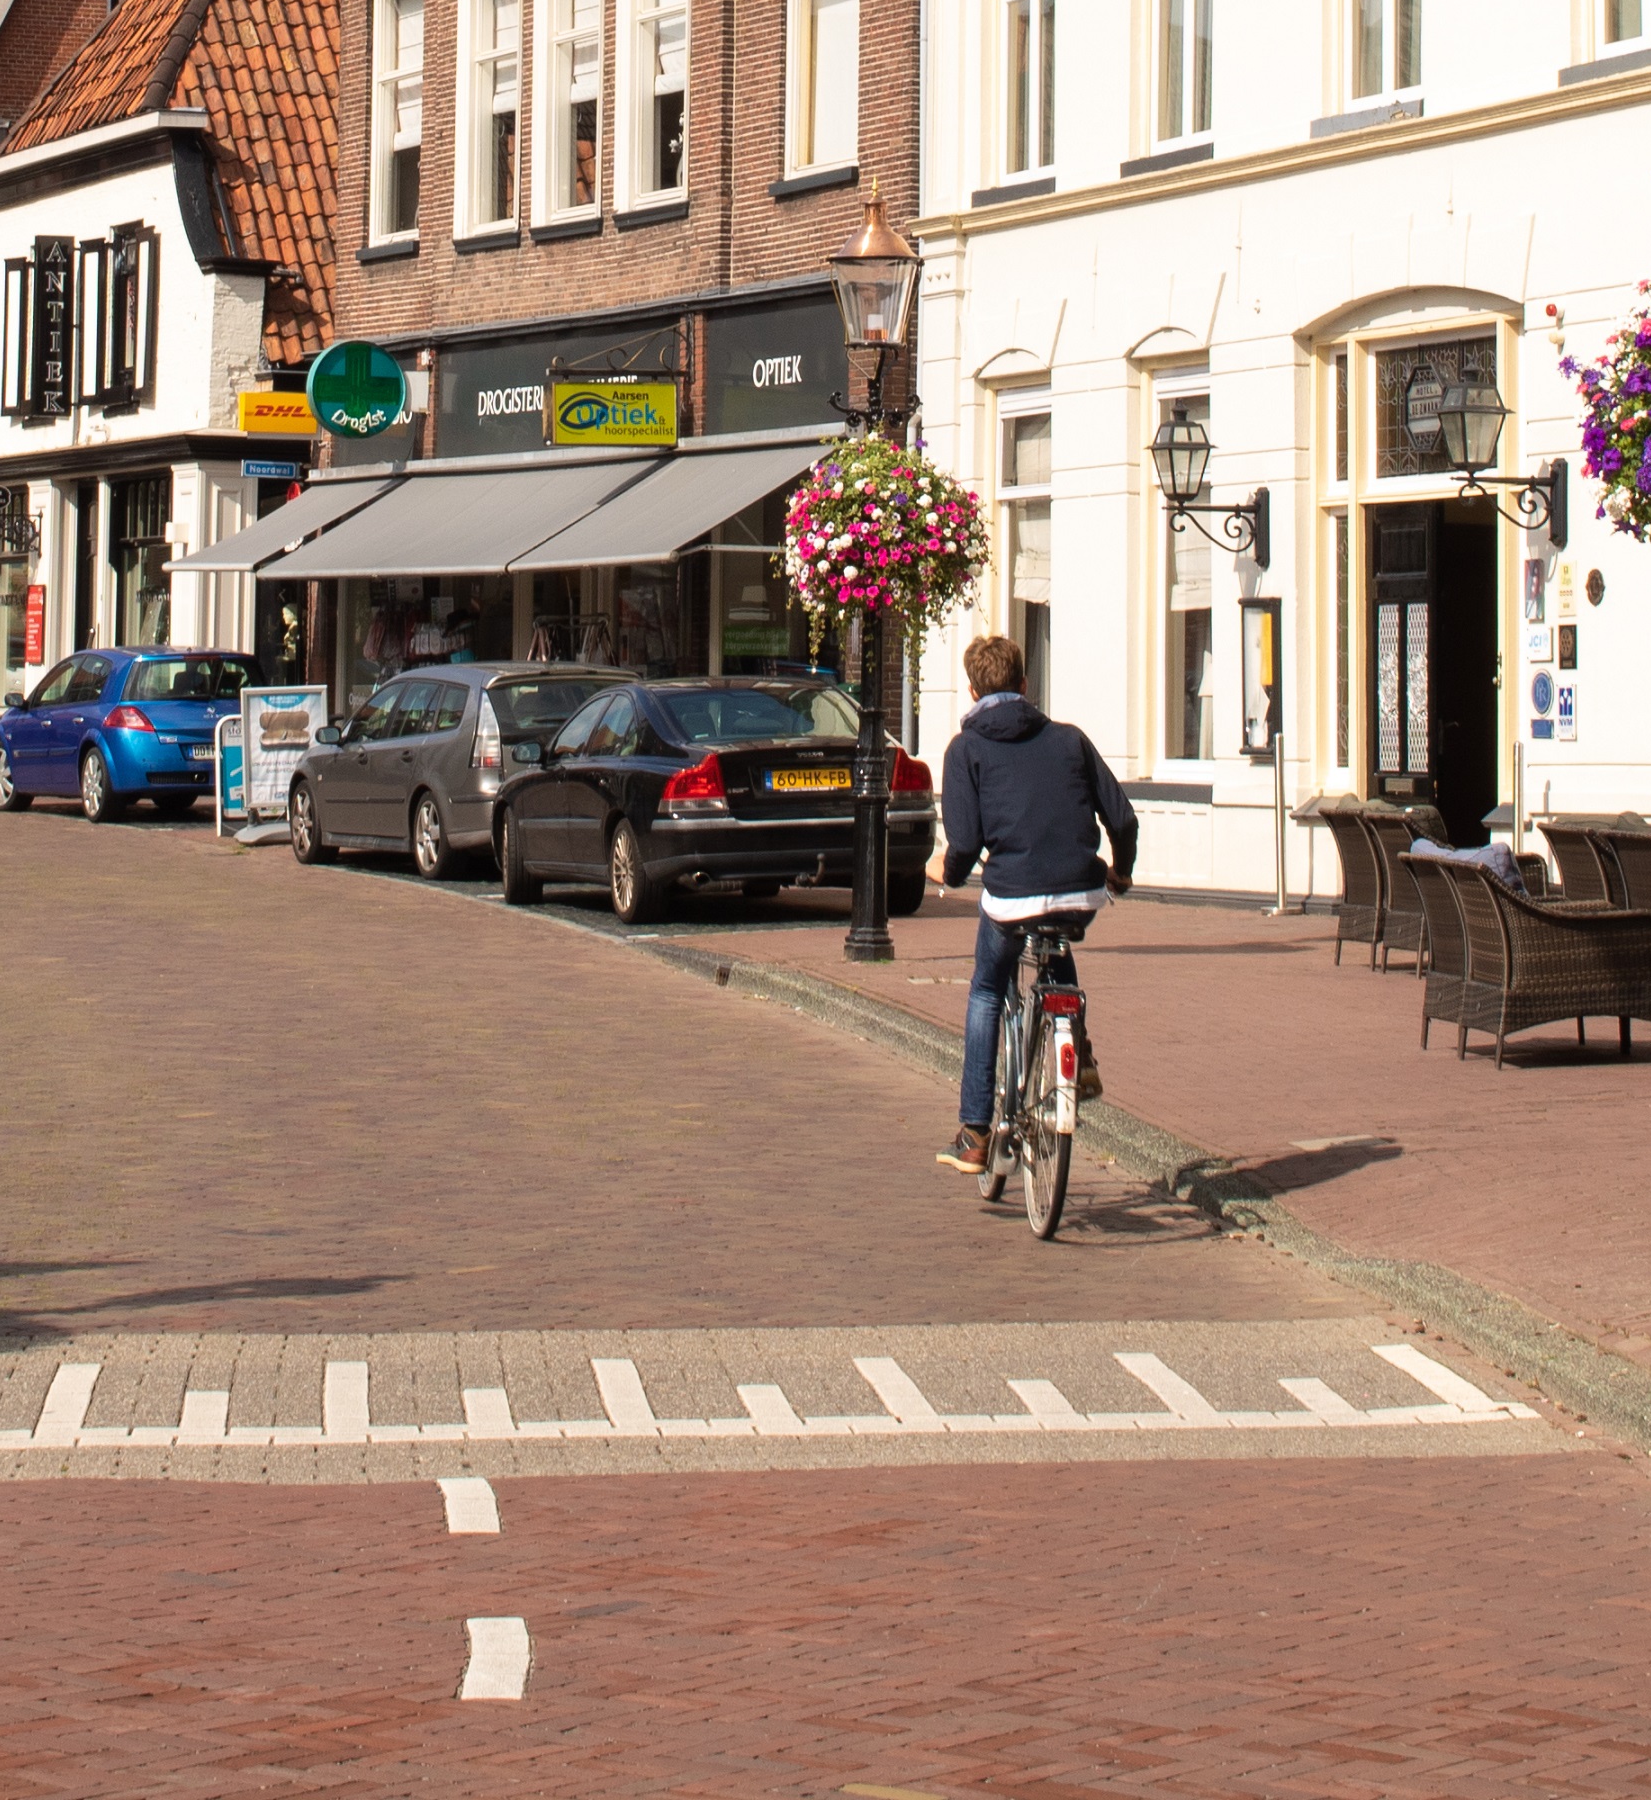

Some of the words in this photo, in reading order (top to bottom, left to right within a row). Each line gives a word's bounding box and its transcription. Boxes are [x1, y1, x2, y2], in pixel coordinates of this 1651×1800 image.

[43, 240, 67, 412] ANTIEK
[752, 354, 803, 388] OPTIEK
[477, 385, 544, 417] DROGISTERI
[612, 391, 649, 401] Aarsen
[254, 405, 307, 418] DHL
[576, 403, 658, 430] Optiek
[604, 426, 675, 438] hoorspecialist
[249, 464, 290, 476] Noordwal
[1559, 718, 1573, 727] NVM
[776, 771, 848, 787] 60-HK-FB
